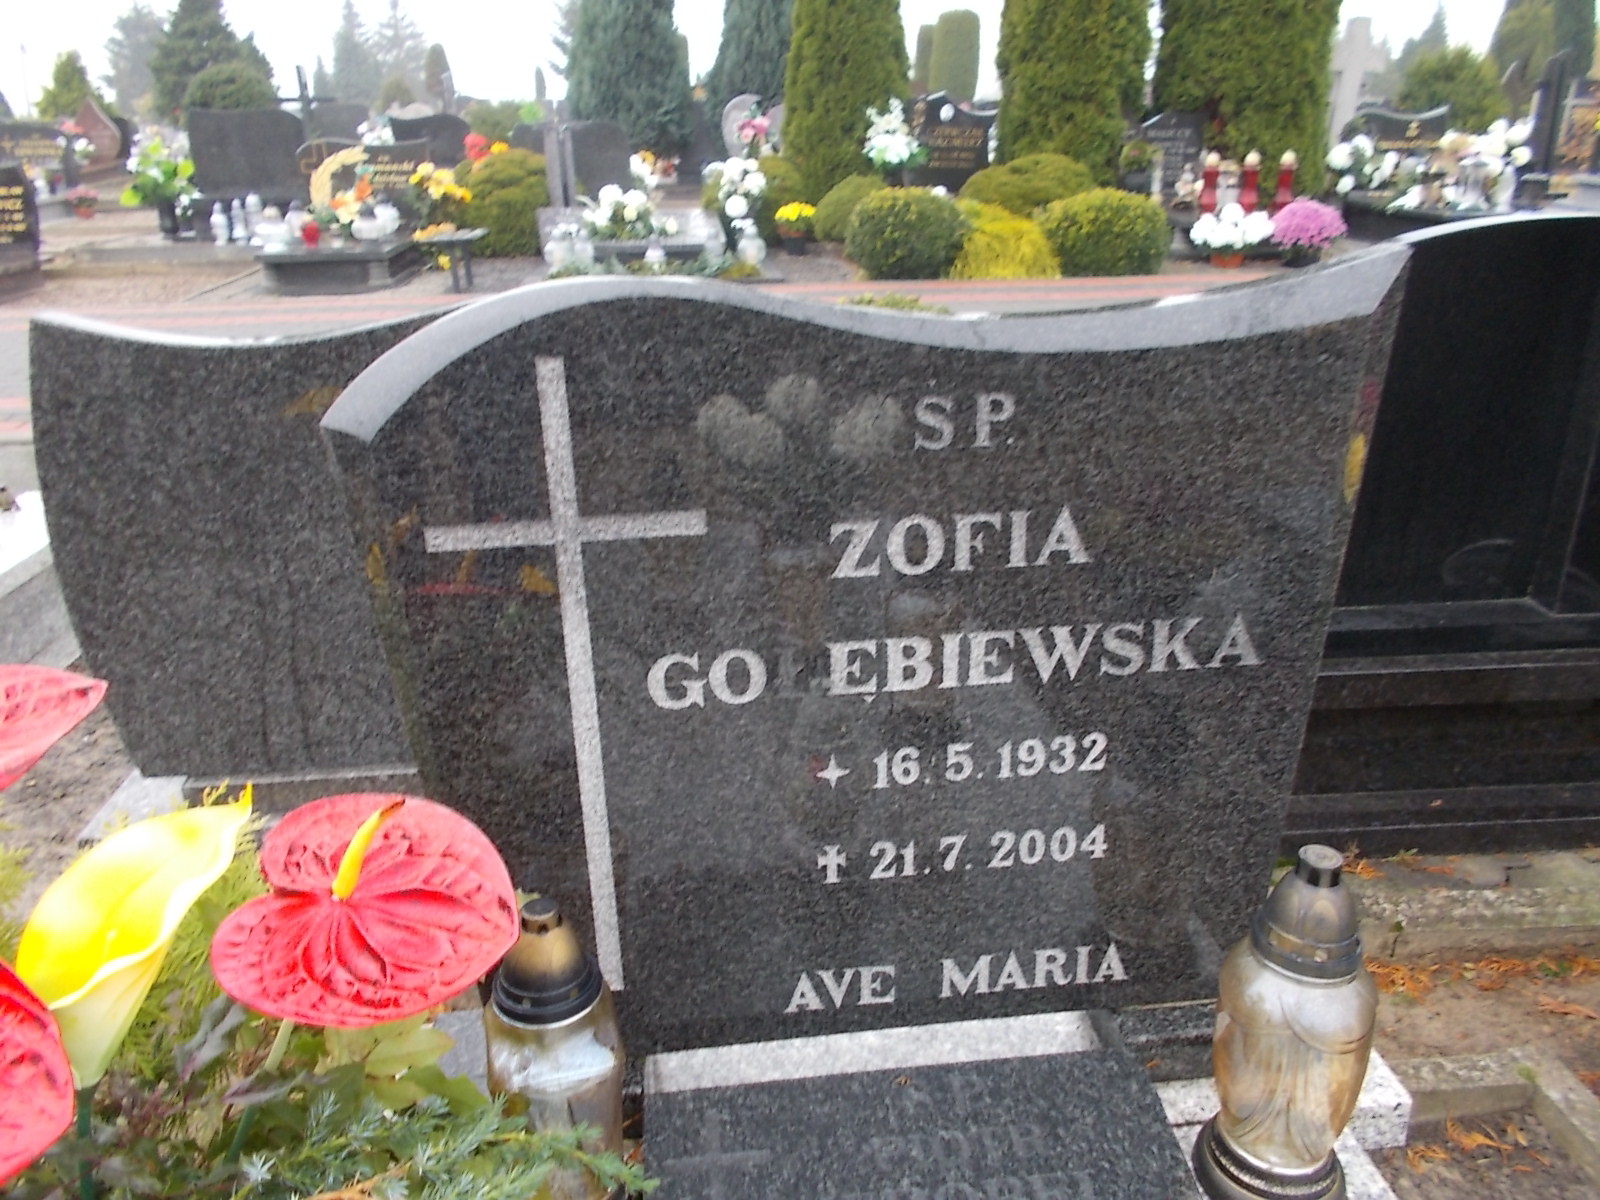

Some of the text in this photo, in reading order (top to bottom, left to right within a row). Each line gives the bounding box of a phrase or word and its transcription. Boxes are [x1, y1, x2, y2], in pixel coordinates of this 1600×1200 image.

[829, 505, 1091, 579] ZOFIA
[784, 941, 1129, 1014] AVE MARIA
